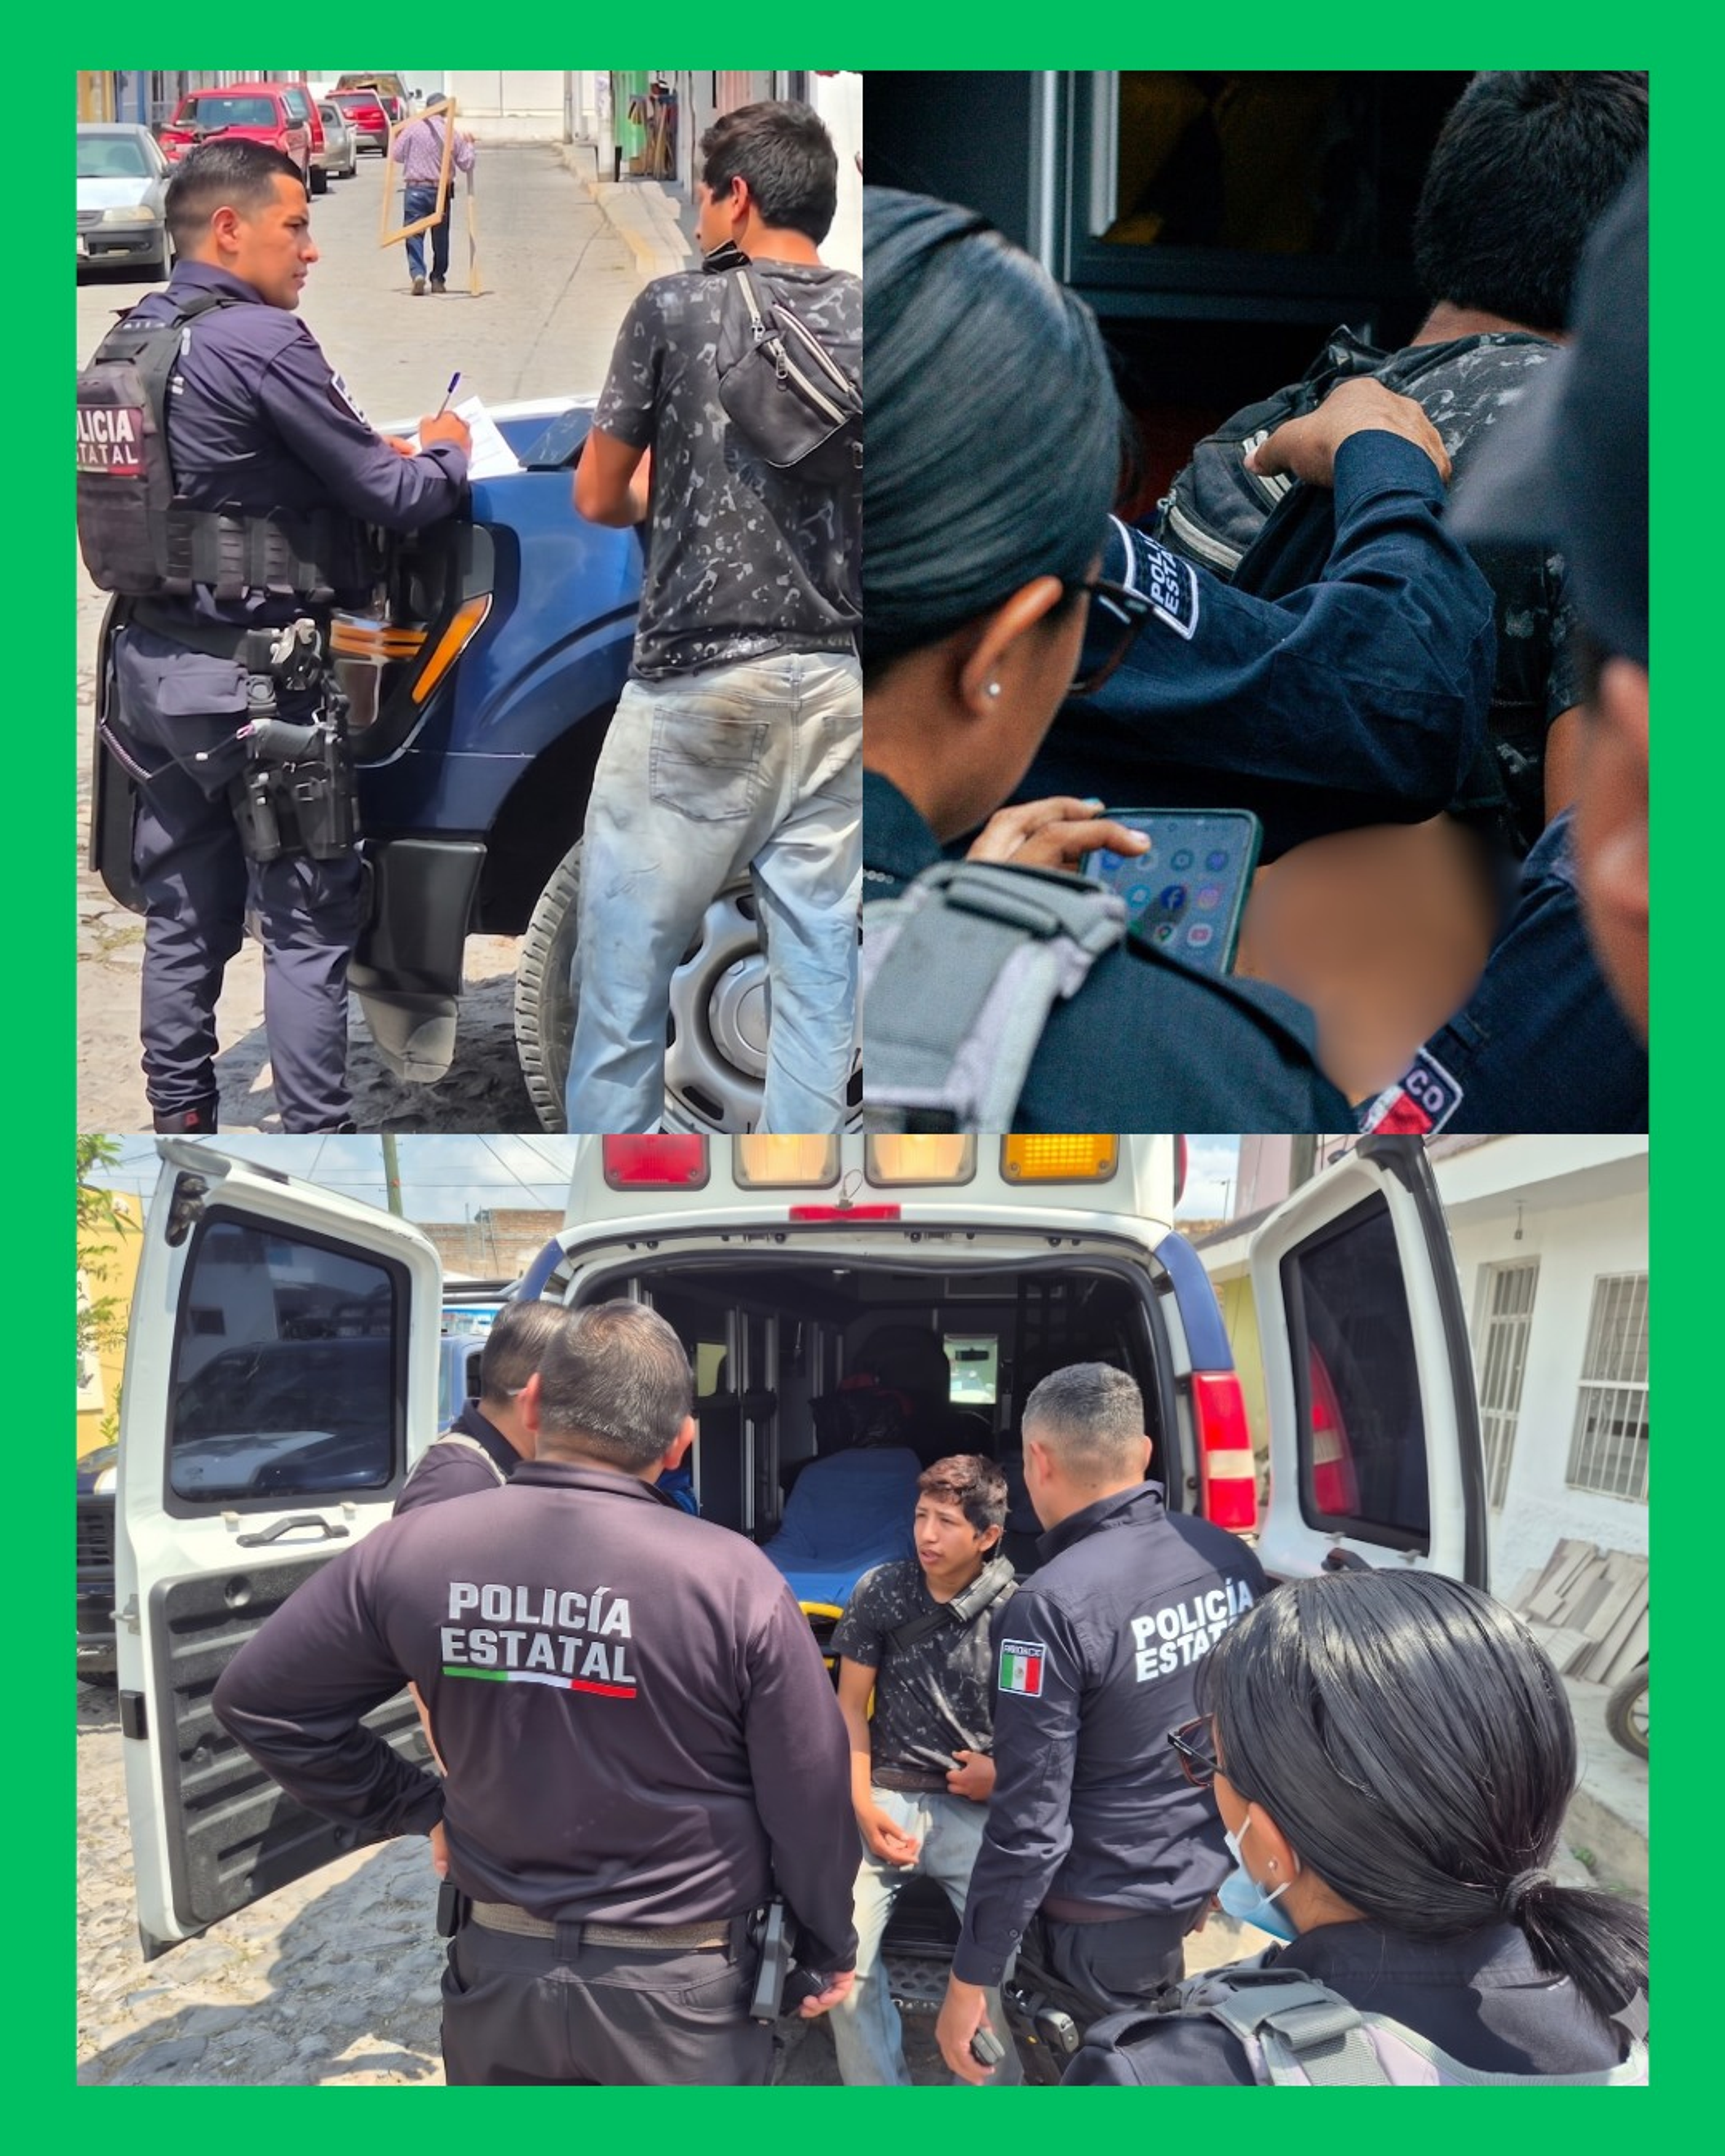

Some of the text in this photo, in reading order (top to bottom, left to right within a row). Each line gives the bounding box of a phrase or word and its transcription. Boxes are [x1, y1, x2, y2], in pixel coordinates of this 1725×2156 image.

[77, 410, 134, 442] LICIA
[77, 443, 138, 464] TATAL
[1406, 1069, 1444, 1112] CO
[449, 1582, 631, 1638] POLICÍA
[1131, 1577, 1254, 1650] POLICÍA
[441, 1627, 636, 1683] ESTATAL
[1136, 1617, 1237, 1682] ESTAT
